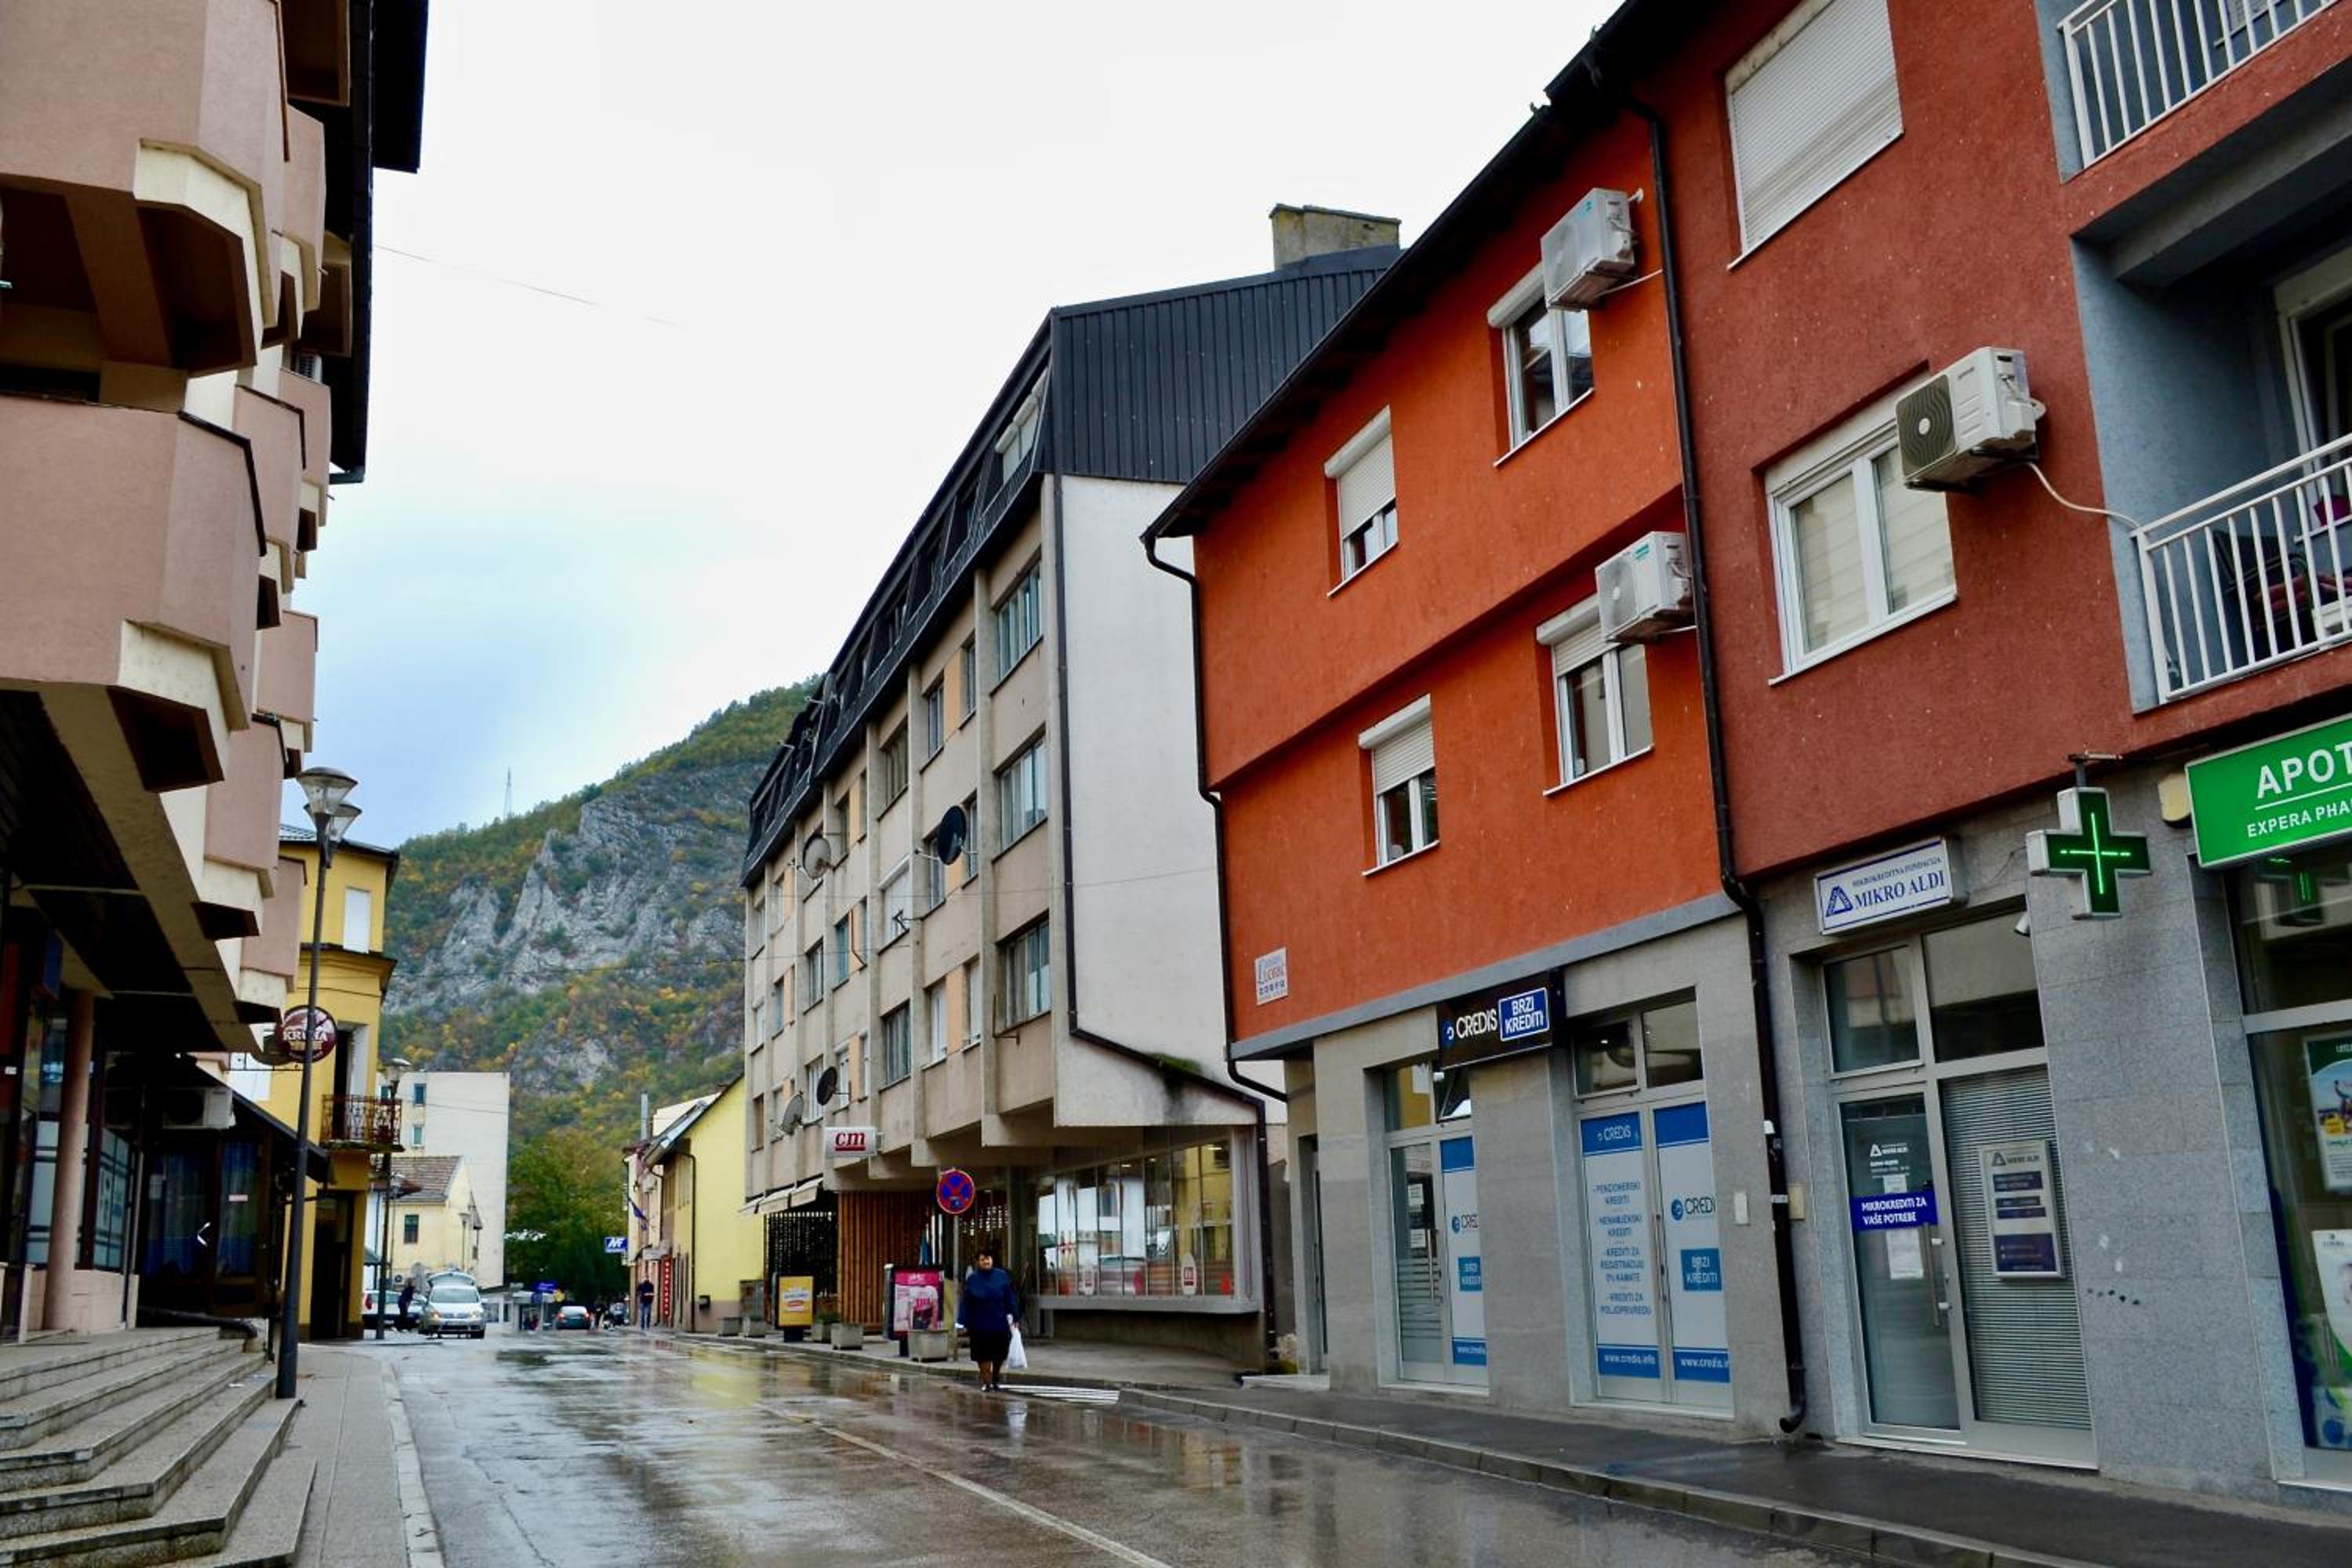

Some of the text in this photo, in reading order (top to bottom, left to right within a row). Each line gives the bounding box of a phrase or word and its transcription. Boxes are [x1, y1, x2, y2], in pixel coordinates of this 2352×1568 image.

[2247, 798, 2352, 838] EXPERA PHA
[1854, 881, 1905, 909] MIKRO
[1908, 870, 1945, 895] ALDI
[1511, 996, 1534, 1016] BRZI
[1456, 1008, 1498, 1039] CREDIS
[1504, 1010, 1544, 1035] KREDITI
[1603, 1125, 1632, 1141] CREDIS
[1861, 1197, 1927, 1212] MIKROKREDITI ZA
[1863, 1212, 1917, 1225] VAŠE POTREBE
[1691, 1256, 1711, 1268] BRZI
[1686, 1272, 1719, 1284] KREDITI
